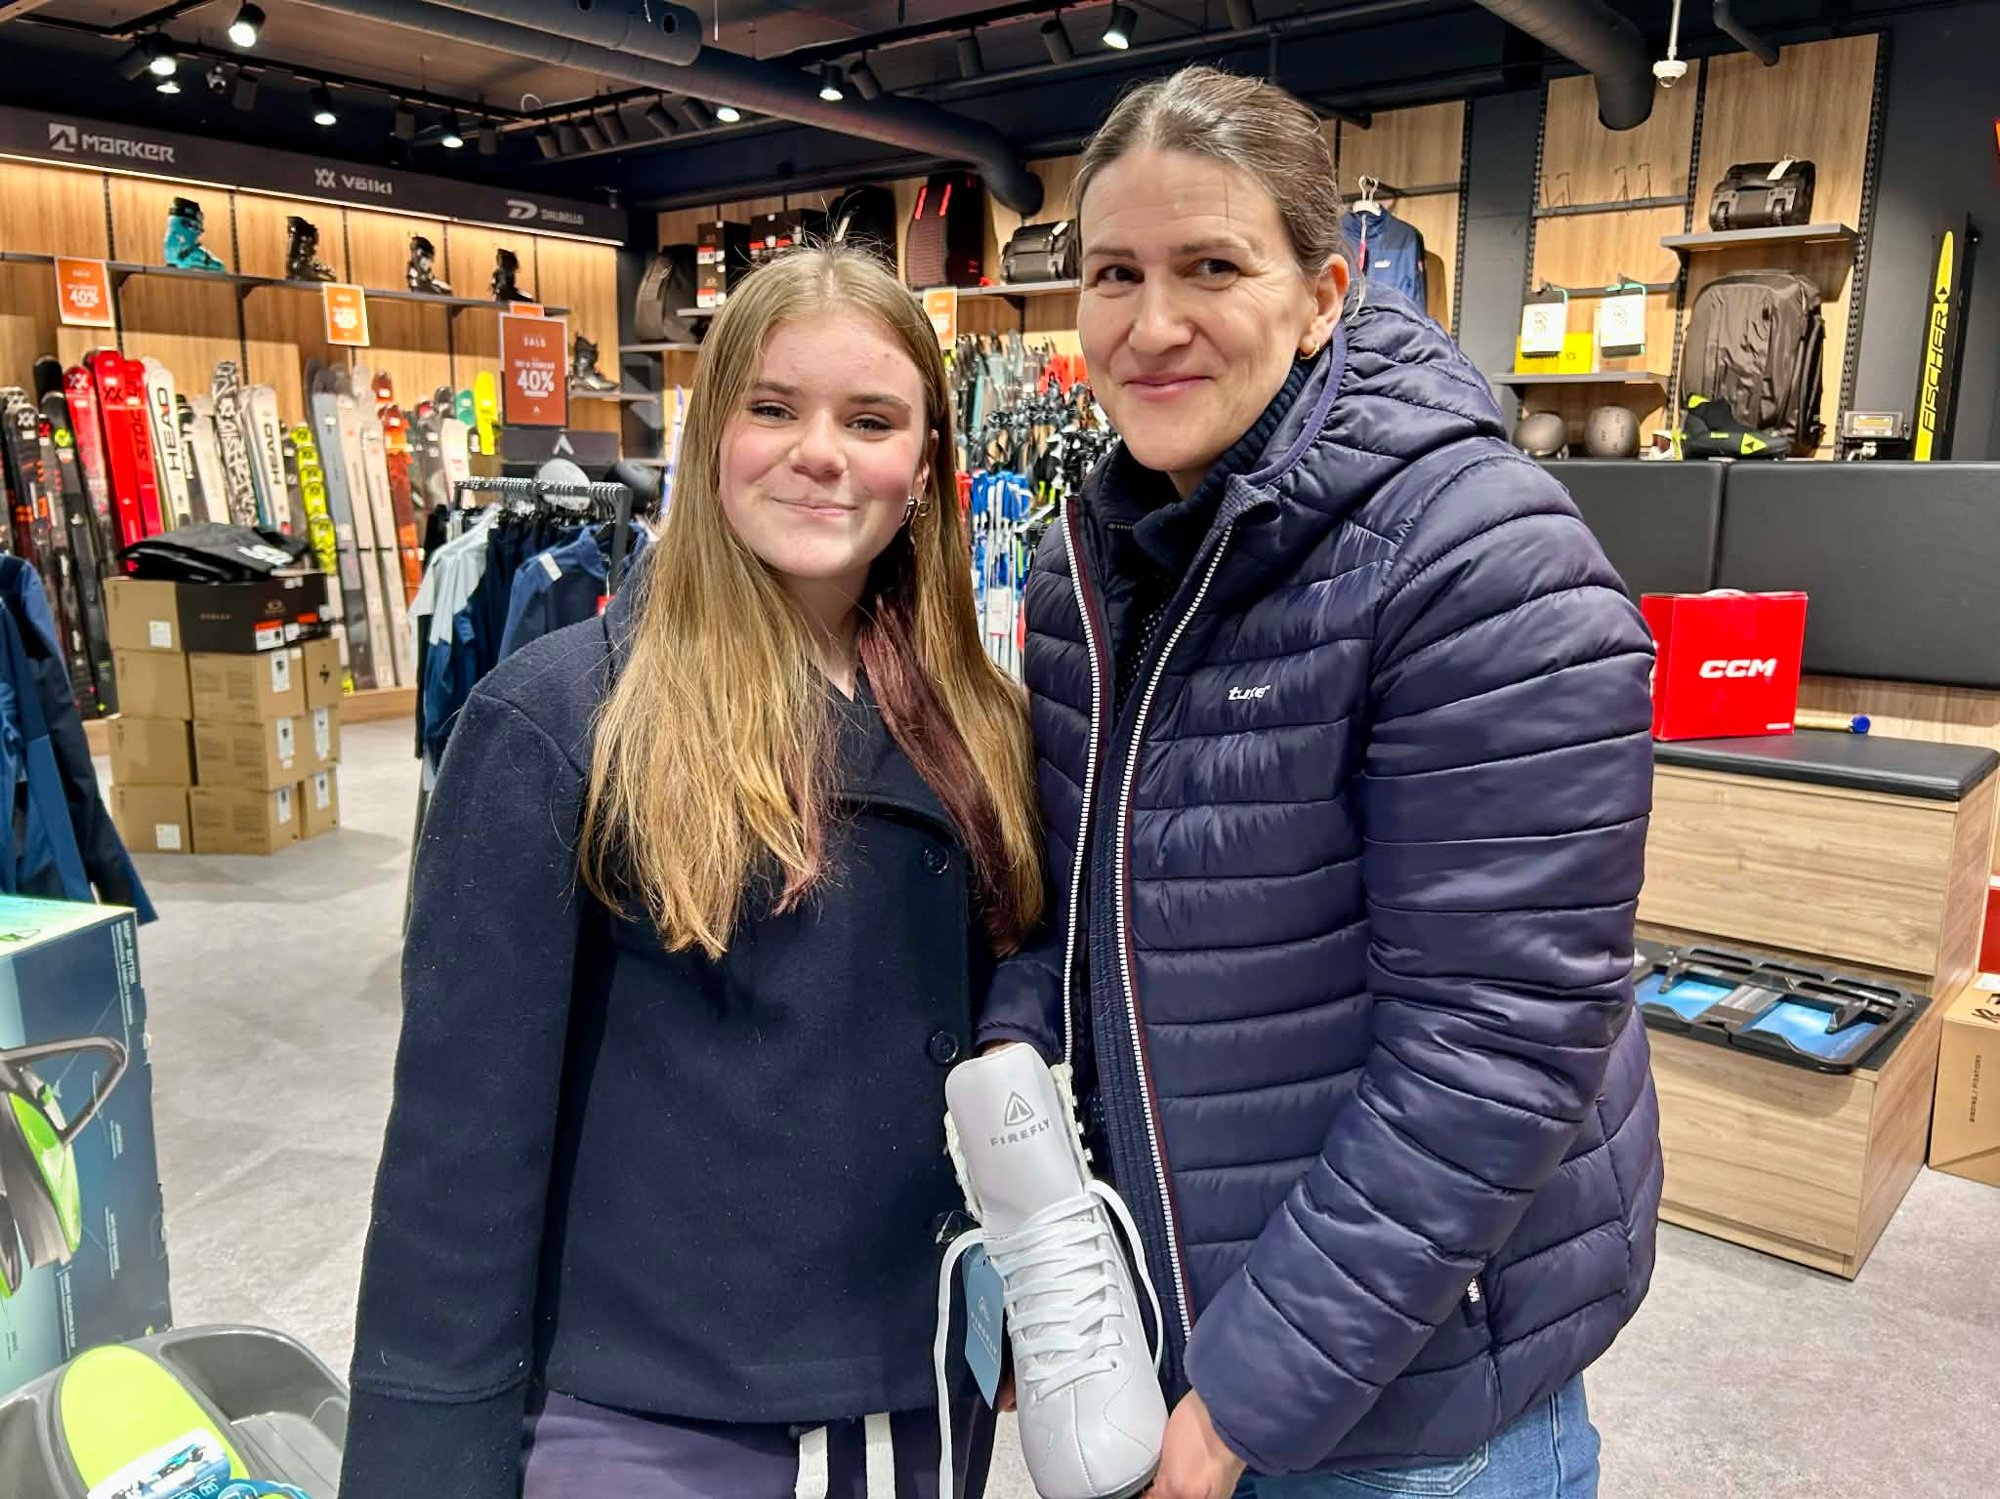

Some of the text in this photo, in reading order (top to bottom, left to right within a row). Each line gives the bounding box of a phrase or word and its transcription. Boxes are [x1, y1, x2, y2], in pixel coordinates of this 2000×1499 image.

[517, 368, 555, 392] 40%
[1922, 310, 1949, 433] FISCHER
[1699, 657, 1777, 679] CCM
[989, 1117, 1050, 1147] FIREFLY
